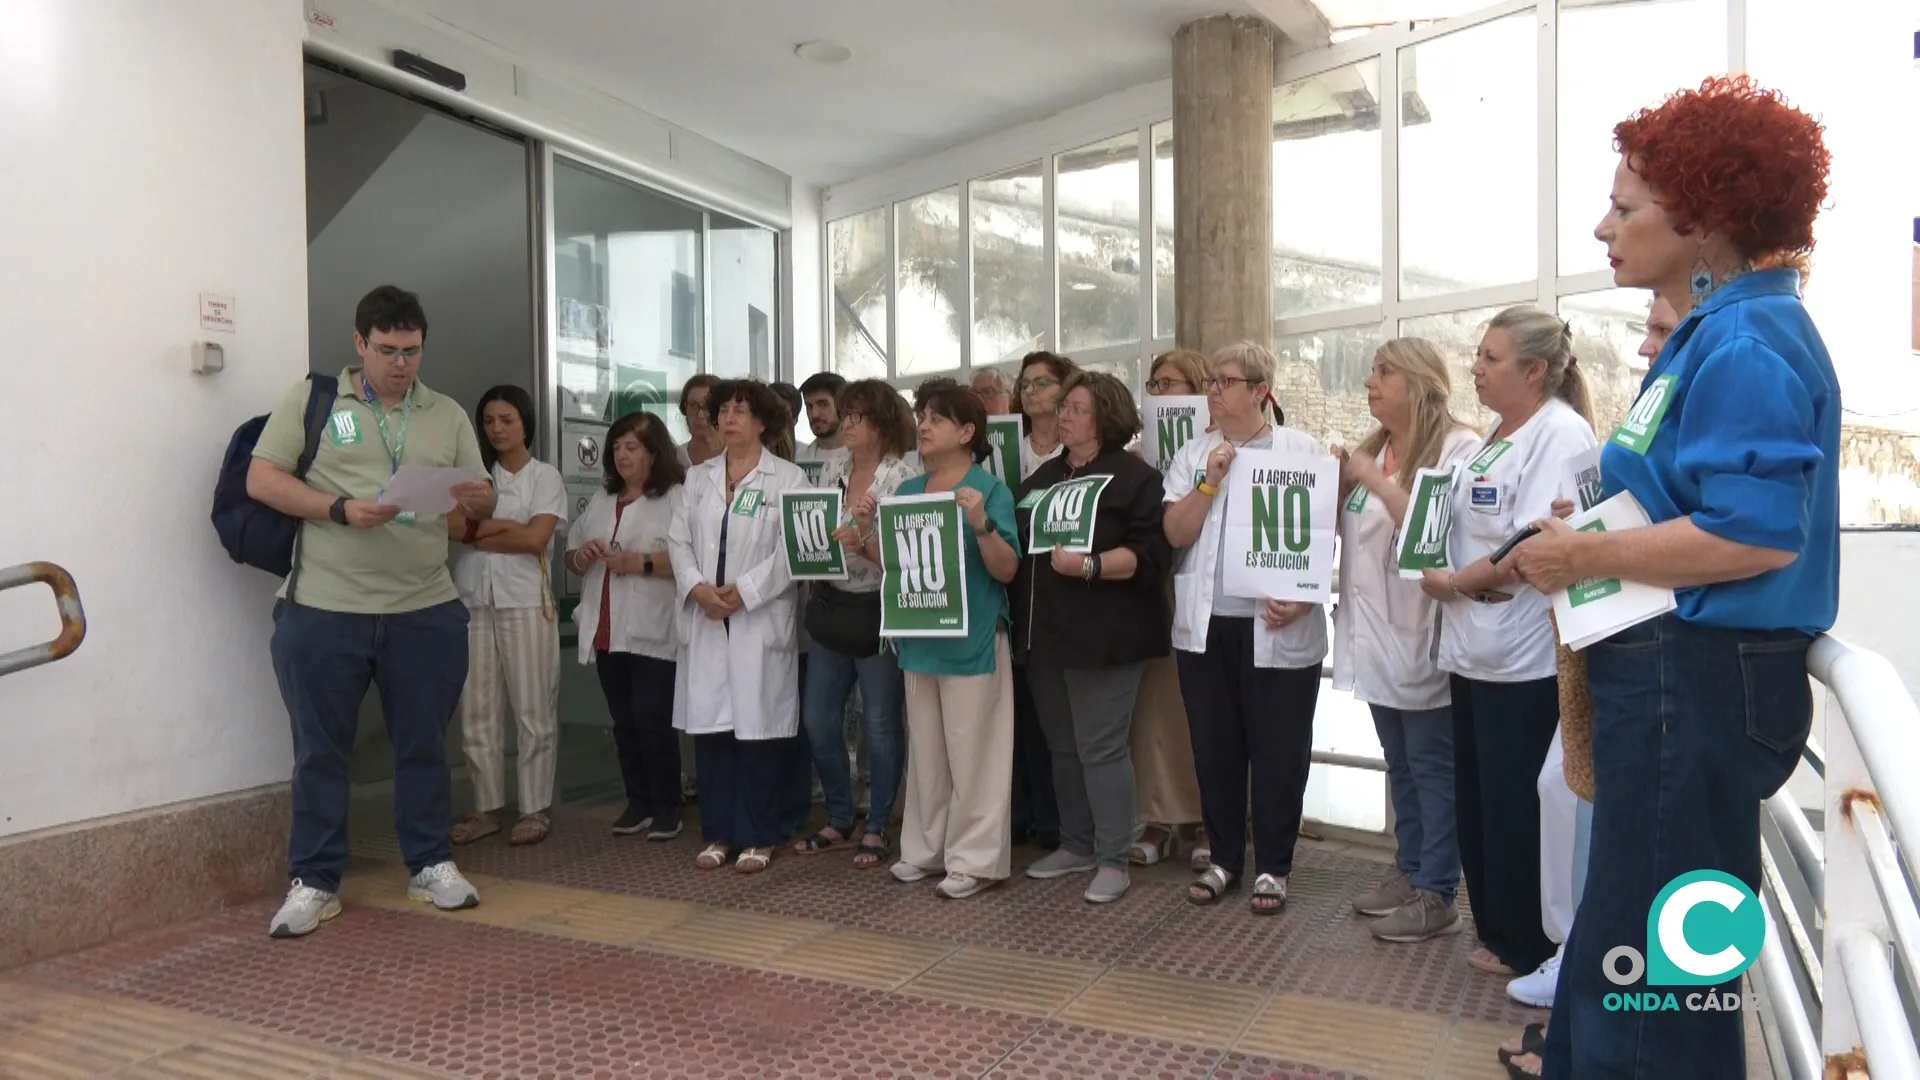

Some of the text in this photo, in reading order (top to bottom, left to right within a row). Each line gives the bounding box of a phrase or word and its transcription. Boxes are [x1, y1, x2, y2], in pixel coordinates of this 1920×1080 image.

[1157, 404, 1196, 418] LA AGRESIÓN
[1628, 386, 1666, 424] NO
[333, 413, 355, 435] NO
[1157, 415, 1194, 460] NO
[1252, 468, 1316, 488] LA AGRESIÓN
[740, 492, 758, 507] NO
[792, 499, 828, 512] LA AGRESIÓN
[1046, 485, 1088, 523] NO
[894, 510, 944, 530] LA AGRESIÓN
[1051, 518, 1080, 532] SOLUCIÓN
[1252, 484, 1311, 552] NO
[793, 508, 829, 555] NO
[895, 526, 946, 595] NO
[1246, 550, 1310, 570] ES SOLUCIÓN
[897, 590, 948, 608] ES SOLUCIÓN
